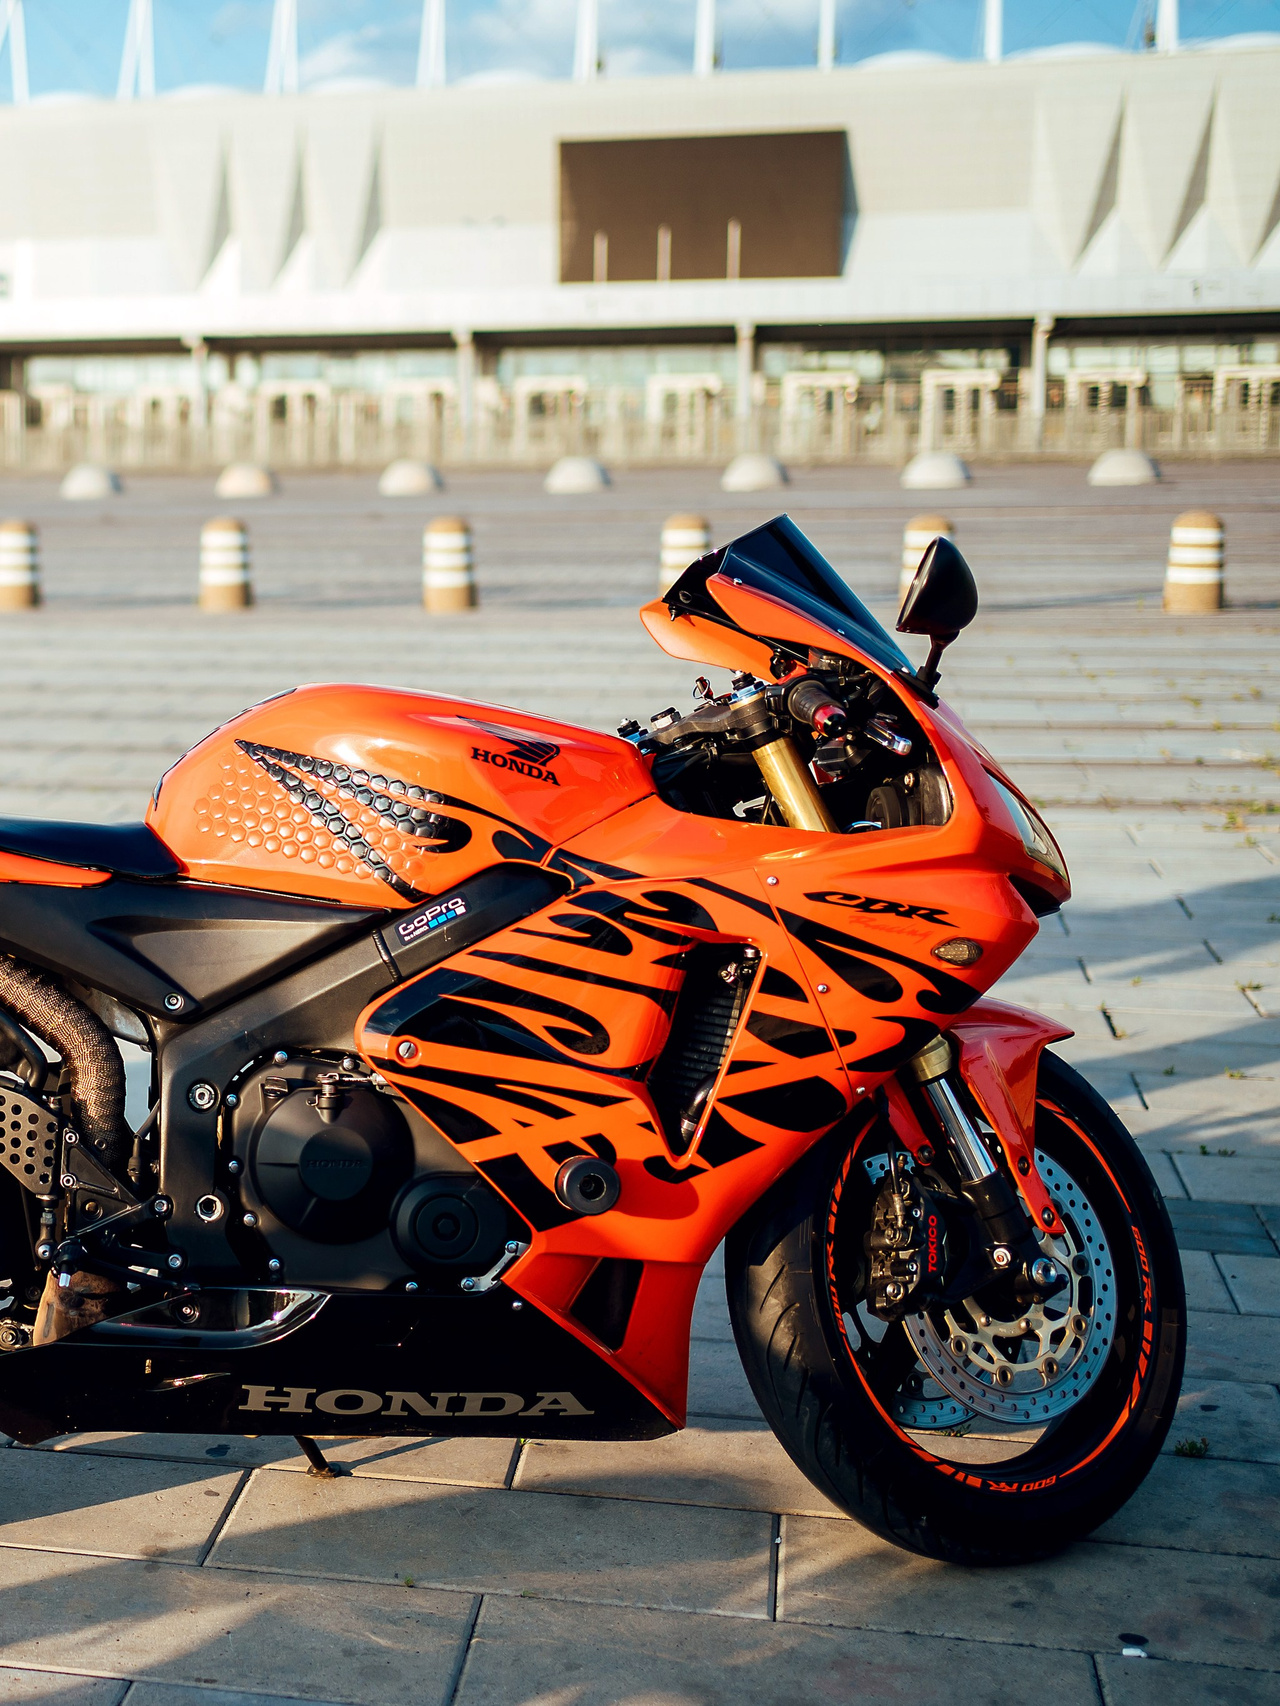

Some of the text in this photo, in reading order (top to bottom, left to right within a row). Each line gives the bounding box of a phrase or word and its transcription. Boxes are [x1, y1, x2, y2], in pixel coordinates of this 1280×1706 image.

[470, 746, 561, 787] HONDA
[398, 897, 466, 936] GoPro
[802, 890, 961, 929] CBR
[928, 1214, 938, 1273] TOKICO
[1131, 1225, 1150, 1273] 600
[238, 1384, 595, 1417] HONDA
[1021, 1474, 1057, 1492] 600
